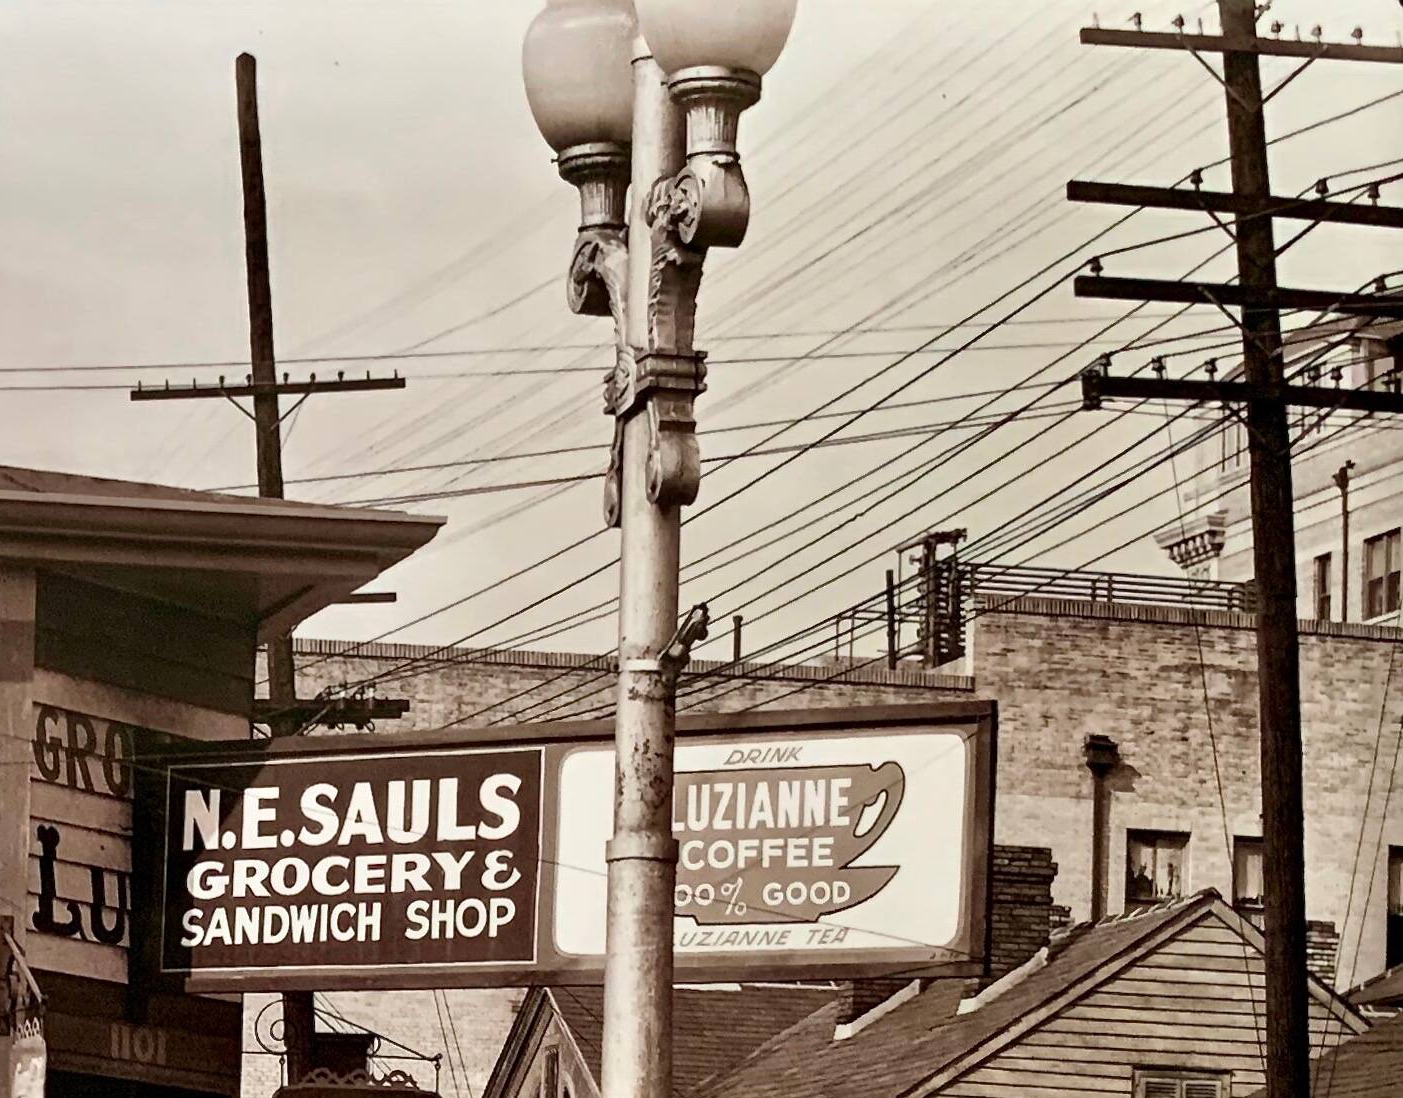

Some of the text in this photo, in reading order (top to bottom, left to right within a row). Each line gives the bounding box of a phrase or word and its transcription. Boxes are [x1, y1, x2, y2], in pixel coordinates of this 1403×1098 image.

[723, 746, 804, 766] DRINK
[681, 836, 835, 870] COFFEE
[186, 850, 522, 900] GROCERY &
[762, 881, 851, 906] GOOD
[180, 897, 516, 948] SANDWICH SHOP
[679, 927, 852, 947] UZIANNE TEA
